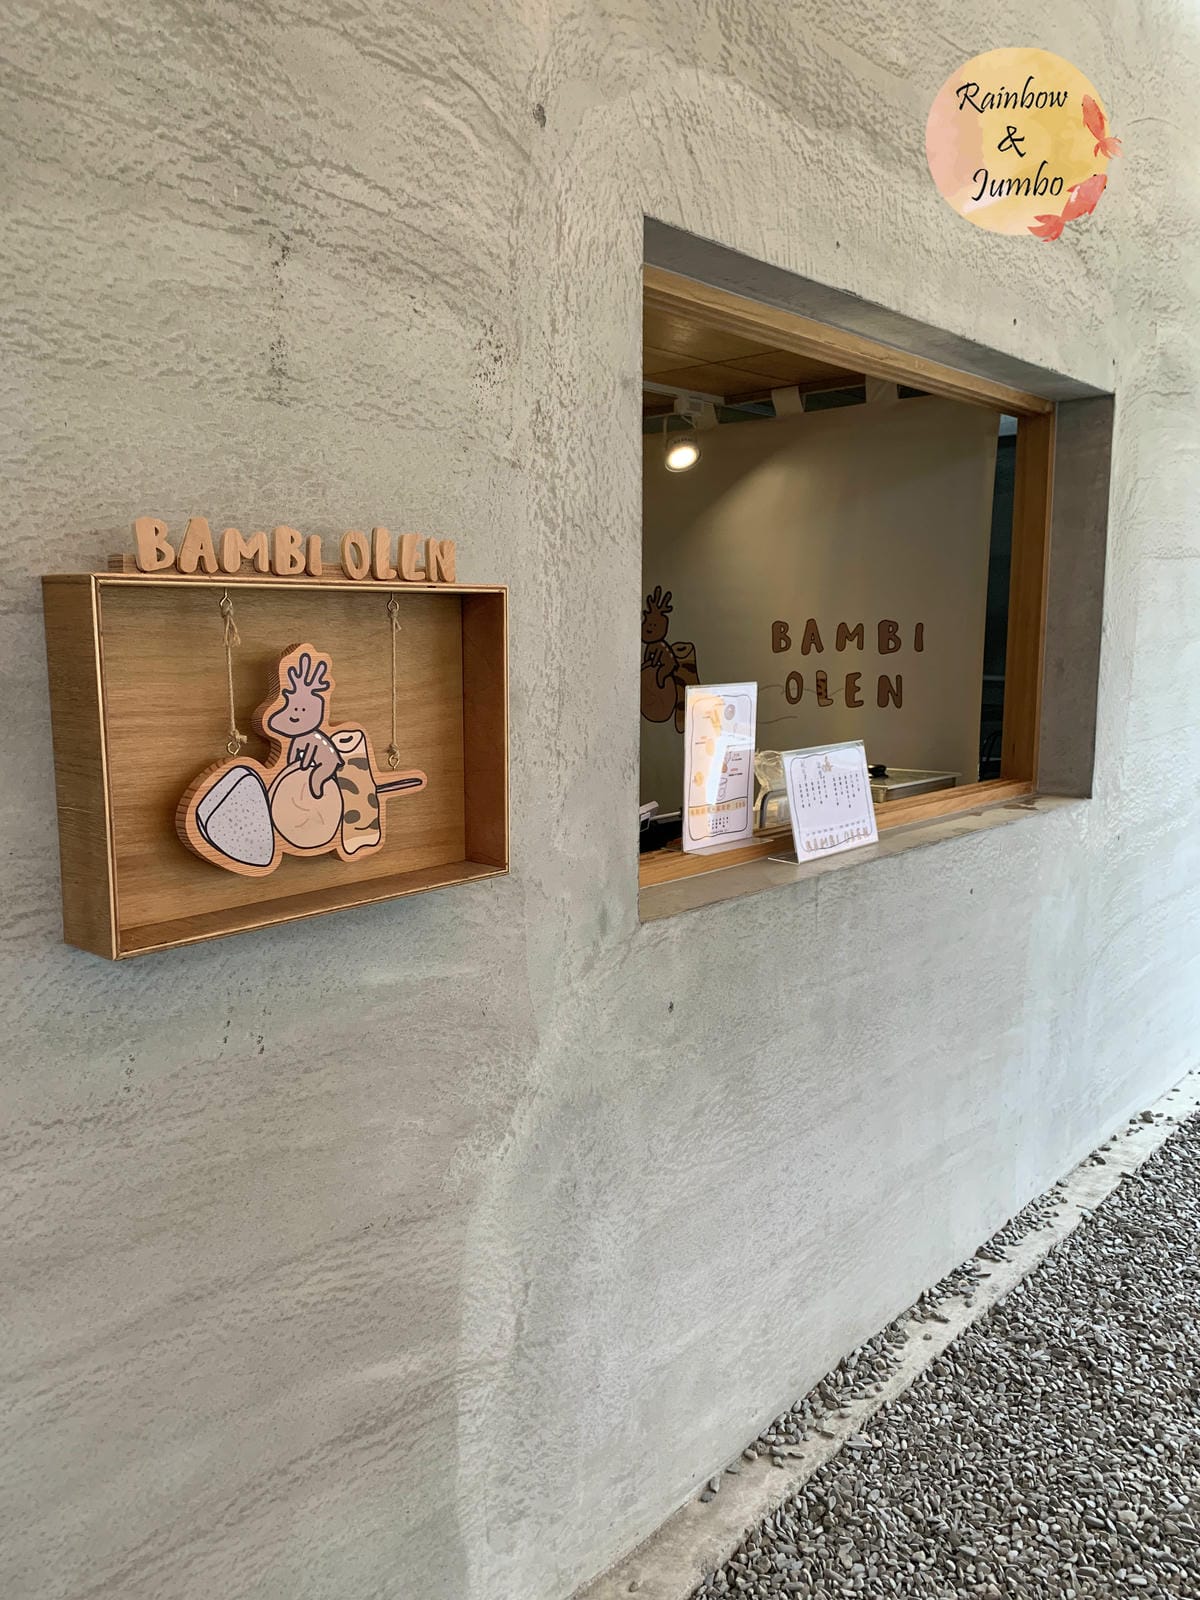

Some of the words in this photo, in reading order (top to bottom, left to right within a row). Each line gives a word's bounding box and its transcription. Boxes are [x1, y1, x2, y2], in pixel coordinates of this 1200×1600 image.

[134, 516, 323, 576] BAMBI
[340, 526, 456, 583] OLEN
[771, 618, 925, 656] BAMBI
[785, 669, 904, 709] OLEN
